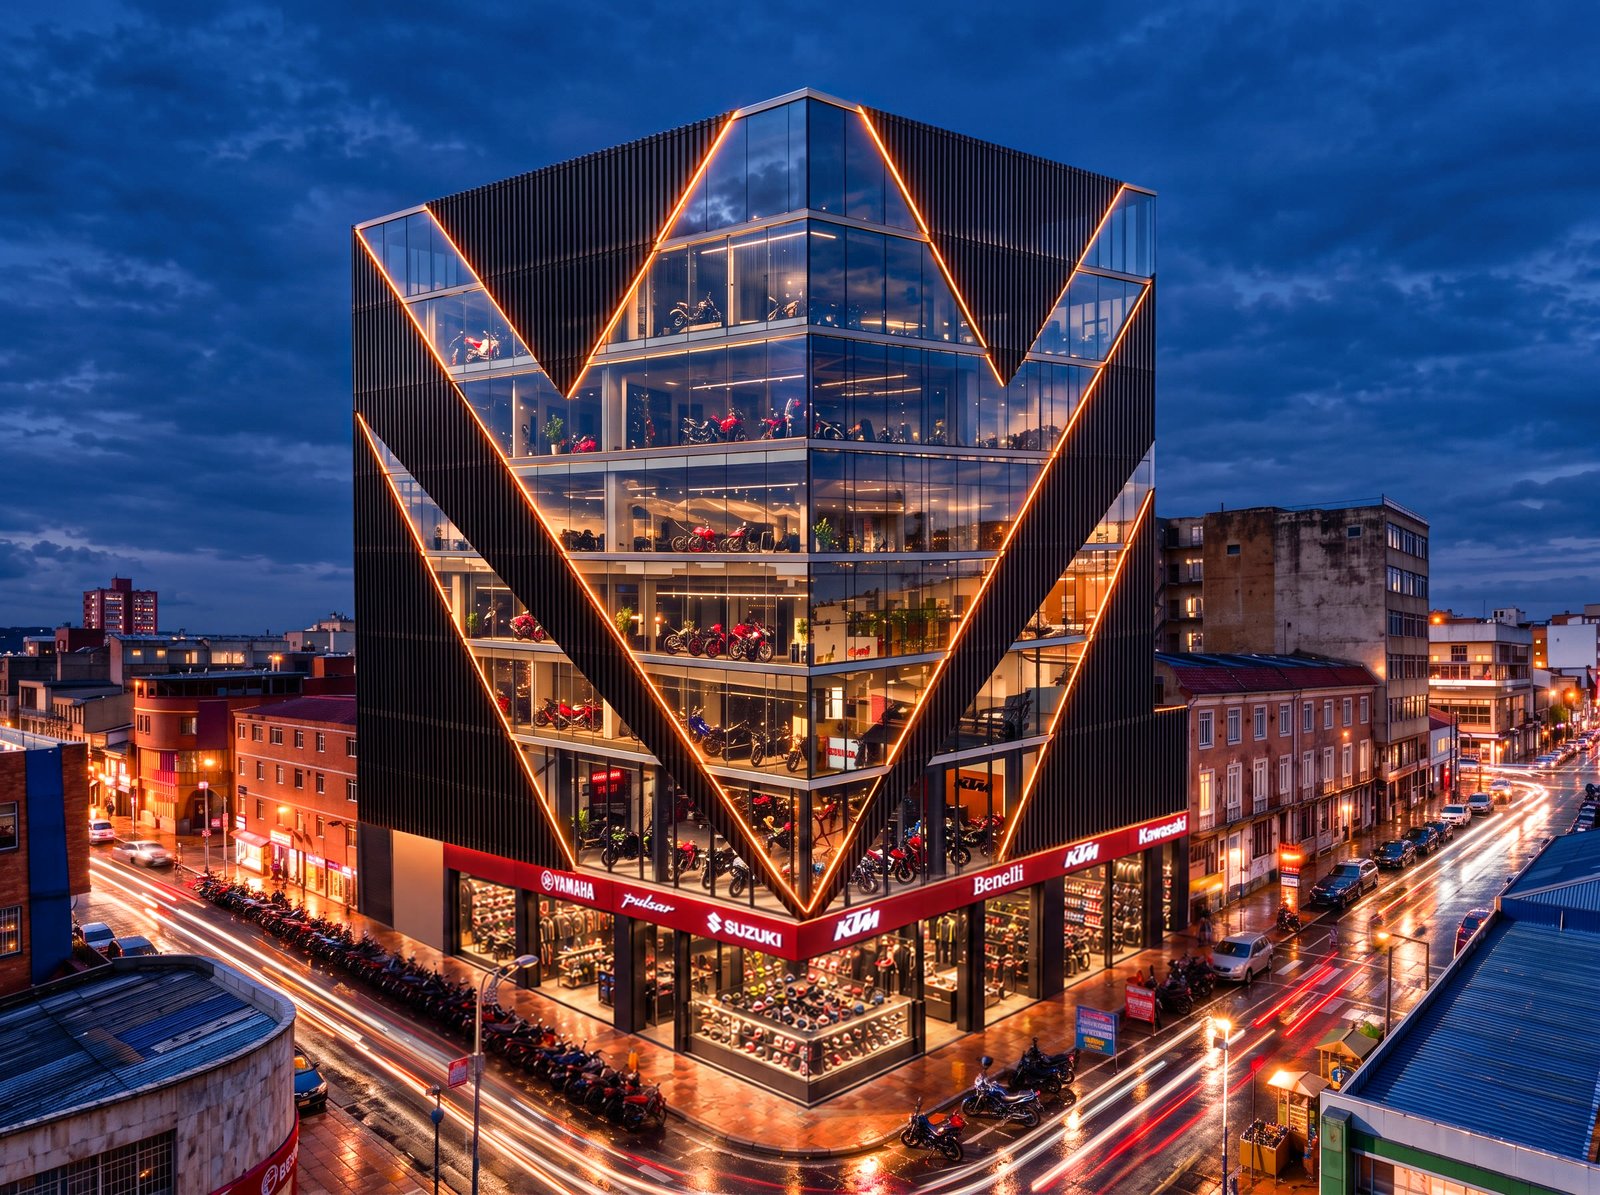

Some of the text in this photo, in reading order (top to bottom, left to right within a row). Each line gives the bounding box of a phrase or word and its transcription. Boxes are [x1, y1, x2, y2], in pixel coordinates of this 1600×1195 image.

[1138, 815, 1187, 845] Kawasaki
[1064, 842, 1100, 868] KTM
[554, 875, 595, 901] YAMAHA
[973, 864, 1024, 897] Benelli
[621, 892, 676, 915] pulsar
[724, 919, 783, 948] SUZUKI
[833, 908, 881, 942] KTM
